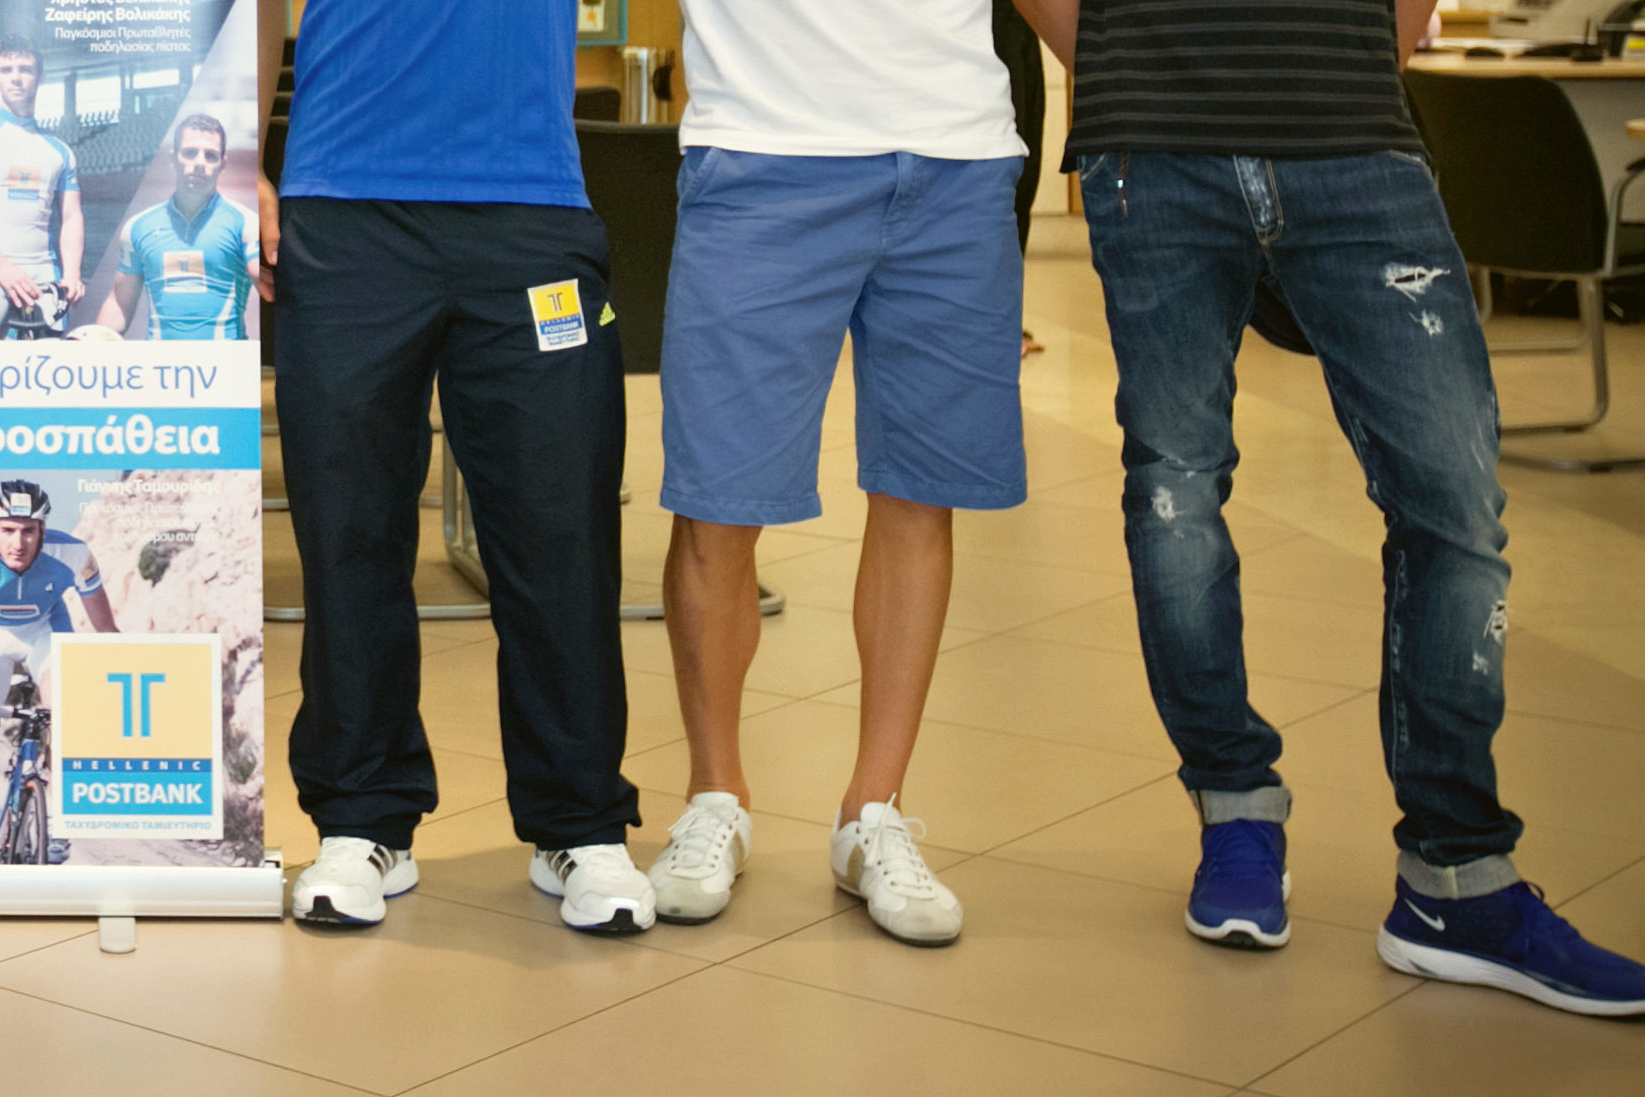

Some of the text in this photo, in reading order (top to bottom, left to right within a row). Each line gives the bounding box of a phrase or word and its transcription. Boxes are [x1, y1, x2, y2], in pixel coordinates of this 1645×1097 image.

[45, 7, 191, 24] Ζαφείρης Βολικάκης
[55, 27, 191, 41] Παγκόσμιοι Πρωταθλητές
[90, 41, 191, 54] ποδηλασίας πίστας
[153, 362, 218, 399] την
[77, 478, 133, 495] Γιάννης
[72, 760, 201, 771] HELLENIC
[72, 782, 203, 804] POSTBANK
[65, 820, 212, 830] ΤΑΧΥΔΡΟΜΙΚΟ ΤΑΜΙΕΥΤΗΡΙΟ
